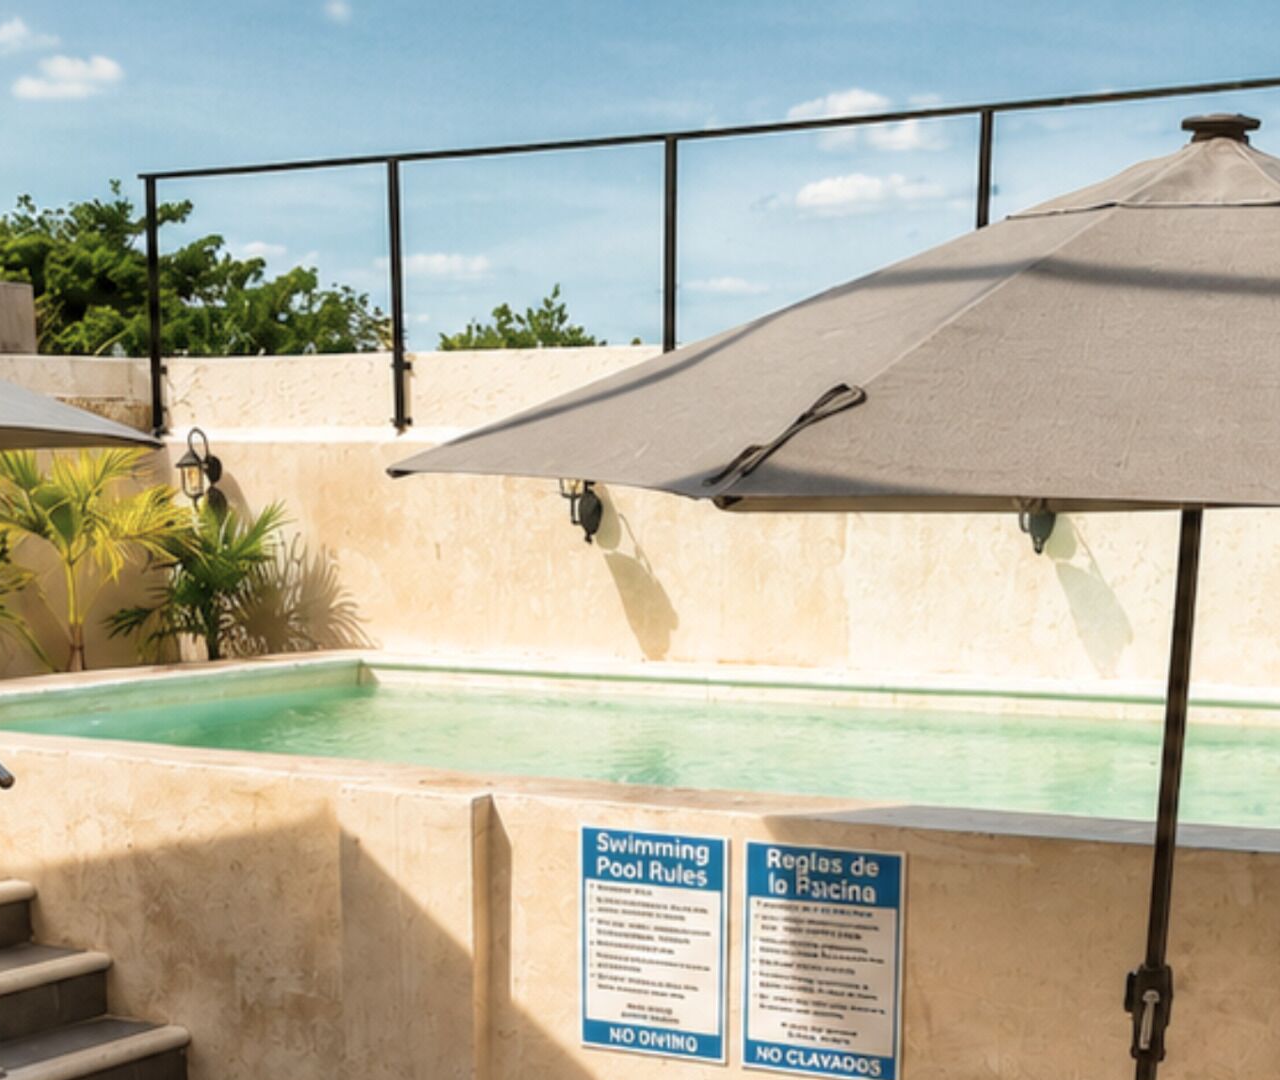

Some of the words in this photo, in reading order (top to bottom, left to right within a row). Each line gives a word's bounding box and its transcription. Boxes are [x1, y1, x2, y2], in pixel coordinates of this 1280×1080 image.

[596, 832, 710, 866] Swimming
[597, 855, 643, 880] Pool
[649, 860, 708, 887] Rules
[850, 856, 880, 877] de
[609, 1026, 635, 1044] NO
[756, 1046, 782, 1063] NO
[786, 1049, 882, 1077] CLAVADOS
